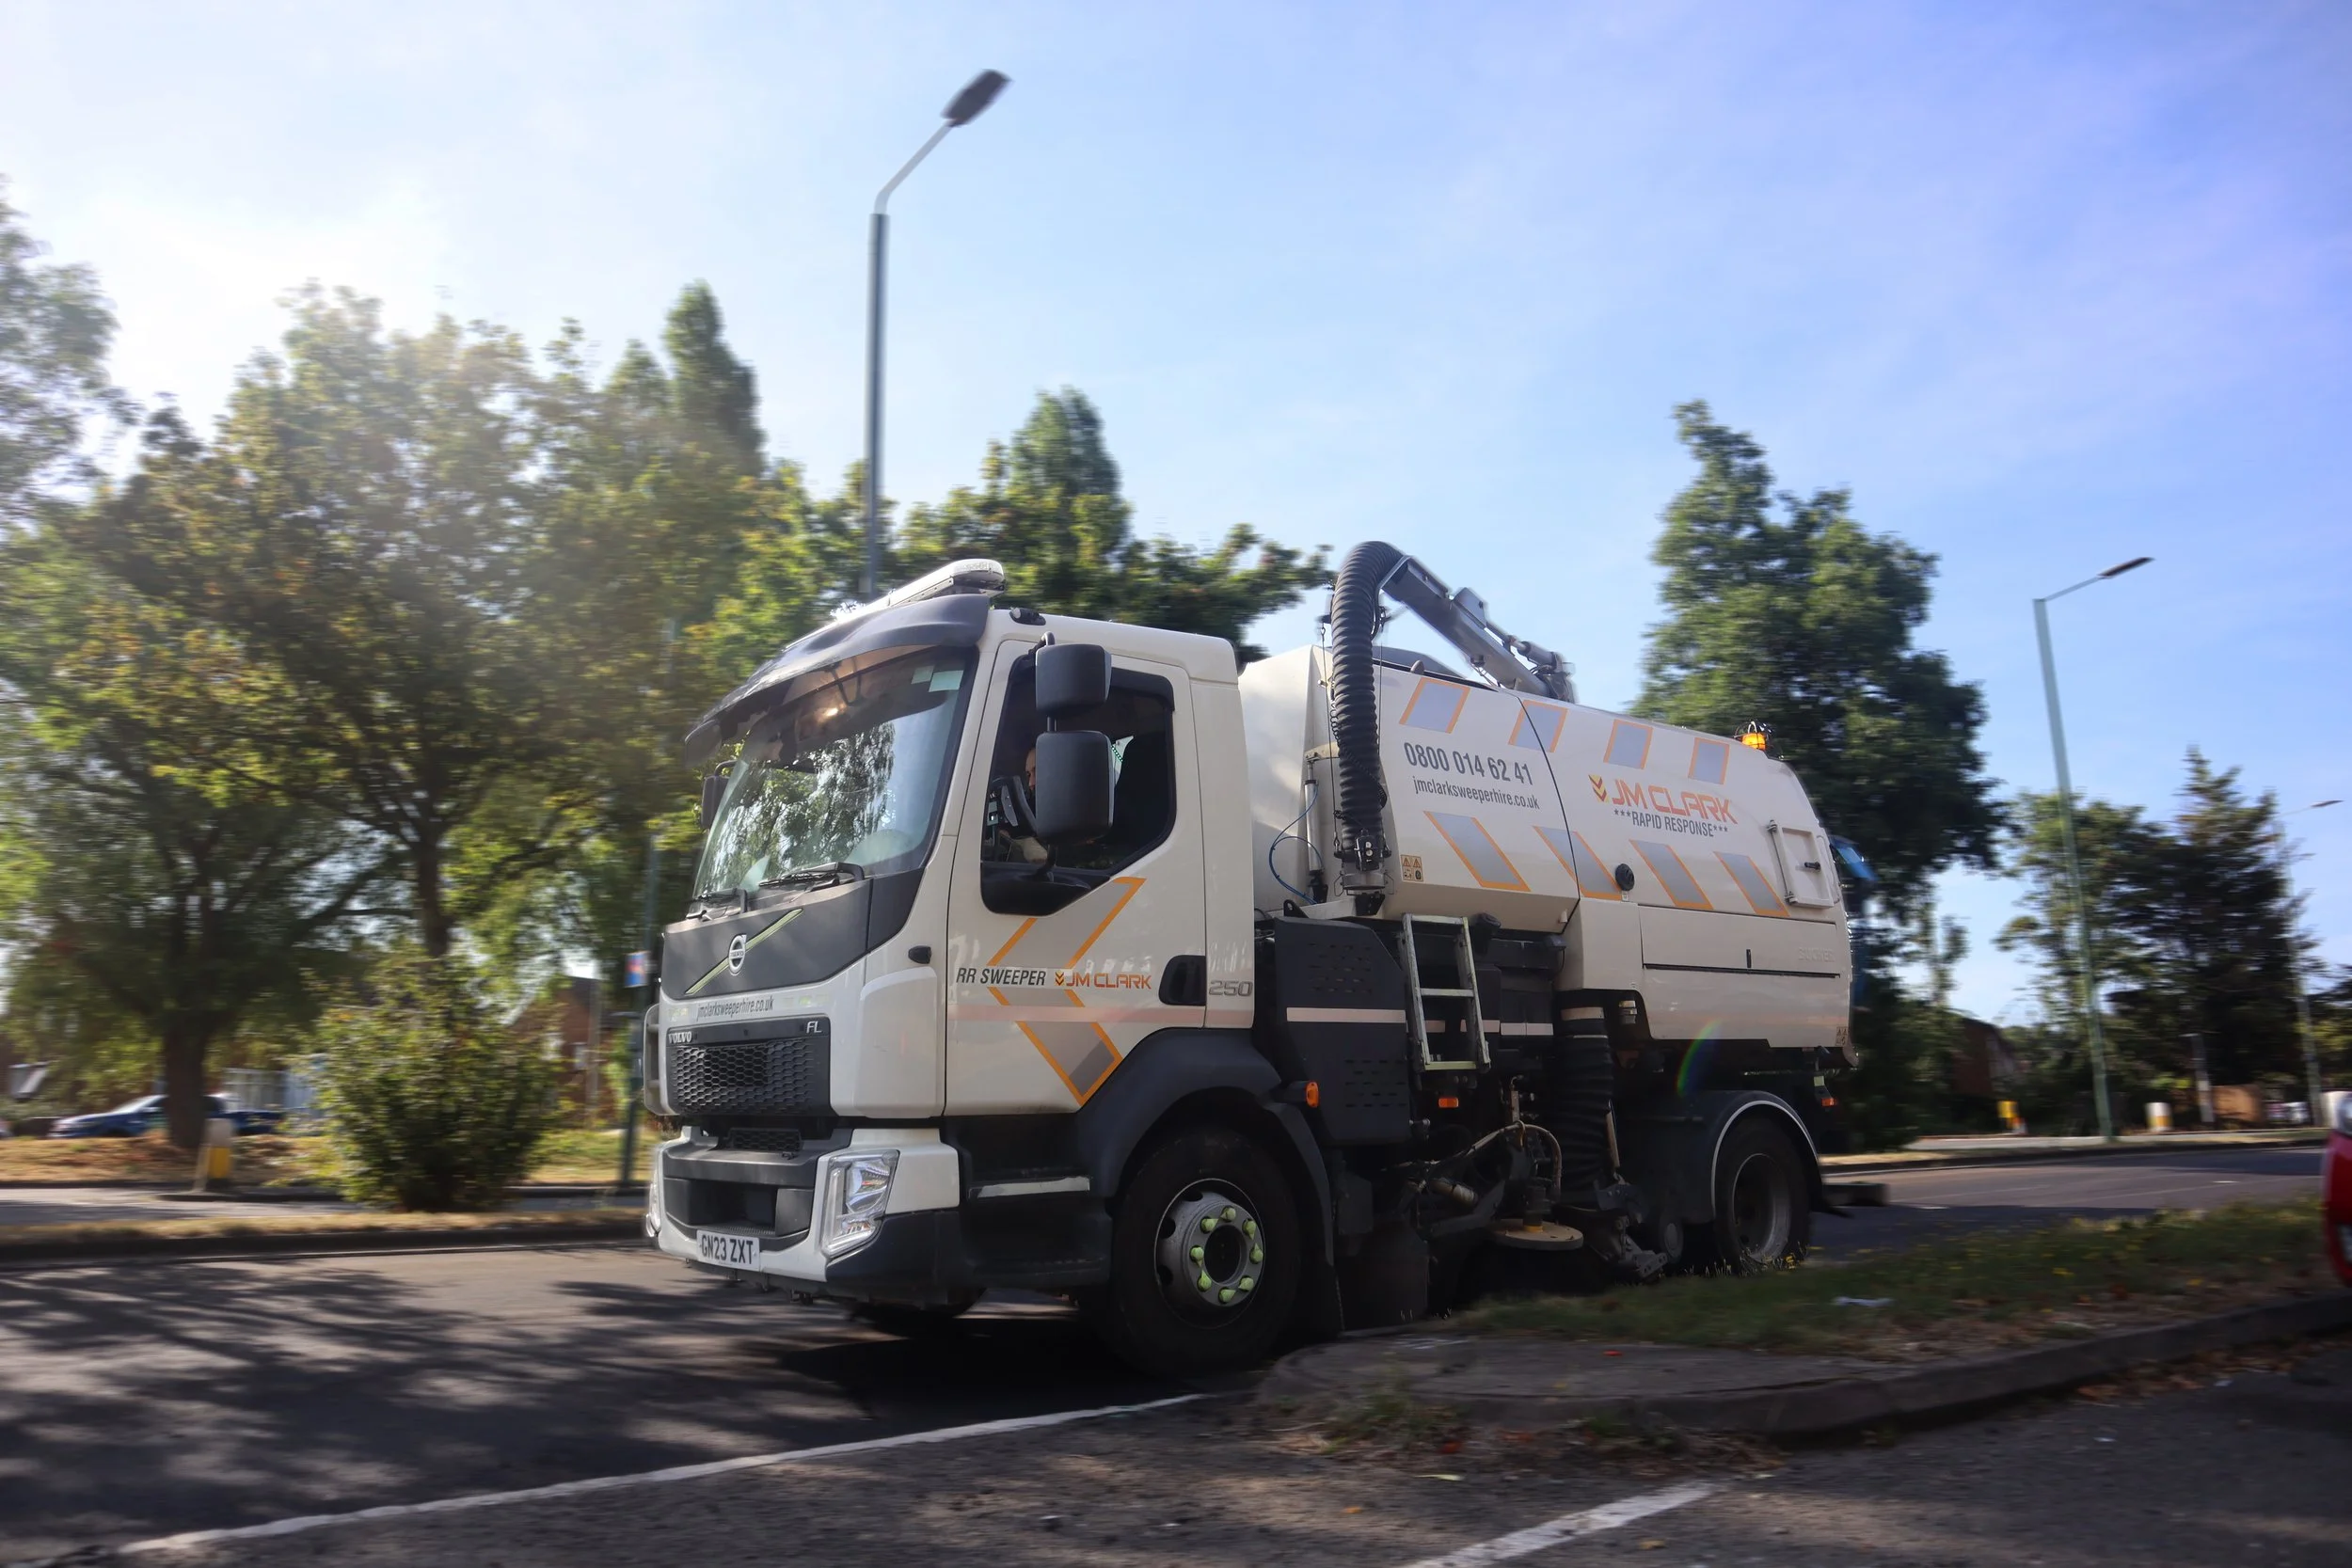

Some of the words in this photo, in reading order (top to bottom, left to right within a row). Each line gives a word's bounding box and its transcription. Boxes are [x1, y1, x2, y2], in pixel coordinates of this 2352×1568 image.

[1404, 742, 1450, 771] 0800
[1453, 751, 1486, 778] 014
[1487, 756, 1511, 782] 62
[1515, 762, 1534, 785] 41
[1413, 776, 1540, 810] jmclarksweeperhire.co.uk
[1613, 779, 1648, 810] JM
[1648, 784, 1739, 825] CLARK
[956, 967, 977, 984] RR
[980, 968, 1047, 986] SWEEPER
[1066, 972, 1090, 988] JM
[1093, 973, 1152, 990] CLARK
[1209, 980, 1253, 996] 250
[696, 995, 774, 1022] jmclarksweeperhire.co.uk
[668, 1031, 692, 1044] VOLVO
[805, 1021, 822, 1034] FL
[701, 1234, 727, 1261] GN23
[729, 1238, 754, 1265] ZXT
